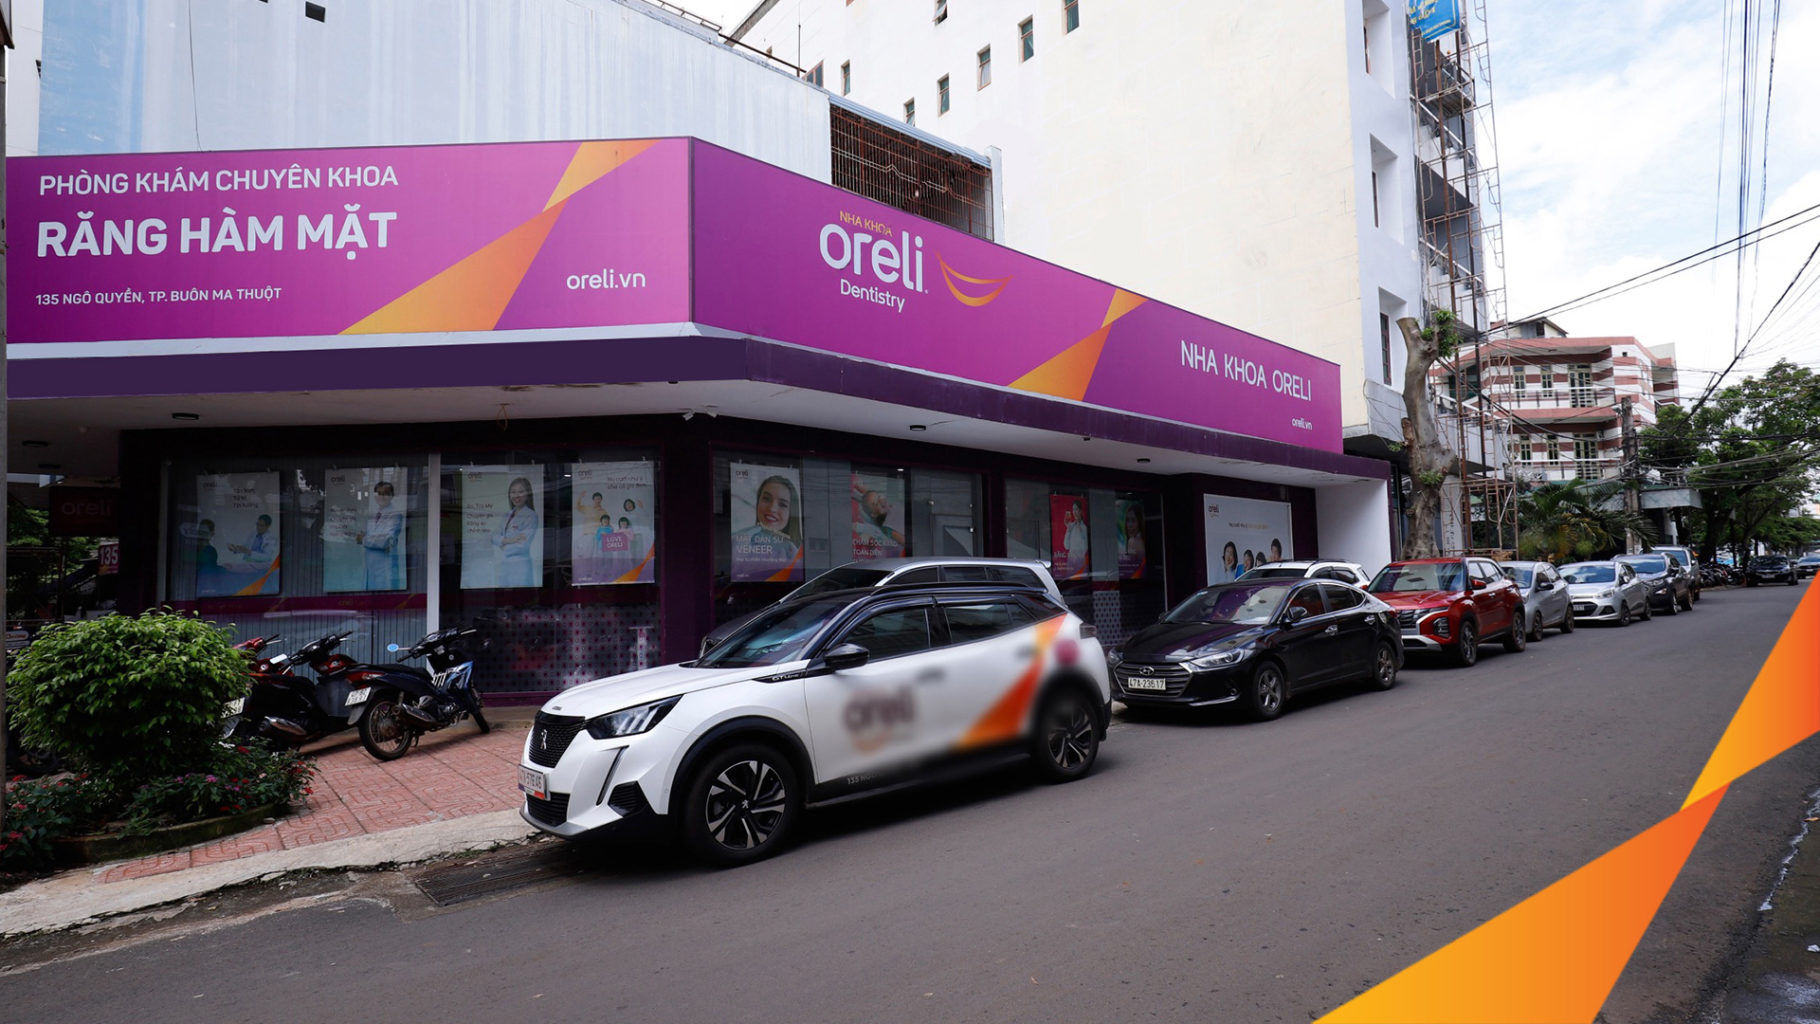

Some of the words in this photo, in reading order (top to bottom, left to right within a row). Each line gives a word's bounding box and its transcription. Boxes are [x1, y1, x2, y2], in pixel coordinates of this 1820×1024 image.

[39, 169, 129, 196] PHÒNG
[135, 167, 209, 193] KHÁM
[215, 163, 321, 190] CHUYÊN
[328, 165, 399, 187] KHOA
[37, 210, 167, 257] RĂNG
[180, 206, 283, 253] HÀM
[298, 203, 397, 260] MẶT
[840, 210, 863, 228] NHA
[864, 218, 893, 237] KHOA
[819, 223, 923, 292] oreli
[566, 268, 646, 290] oreli.vn
[35, 294, 59, 305] 135
[63, 290, 92, 305] NGÔ
[149, 291, 168, 302] TP.
[171, 288, 209, 301] BUÔN
[212, 289, 233, 300] MA
[236, 285, 281, 302] THUỘT
[840, 278, 905, 313] Dentistry
[1181, 340, 1219, 376] NHA
[1224, 353, 1268, 389] KHOA
[1272, 369, 1312, 401] ORELI
[1291, 416, 1313, 431] oreli.vn
[62, 496, 112, 516] oreli
[99, 546, 119, 565] 135
[736, 544, 773, 554] VENEER
